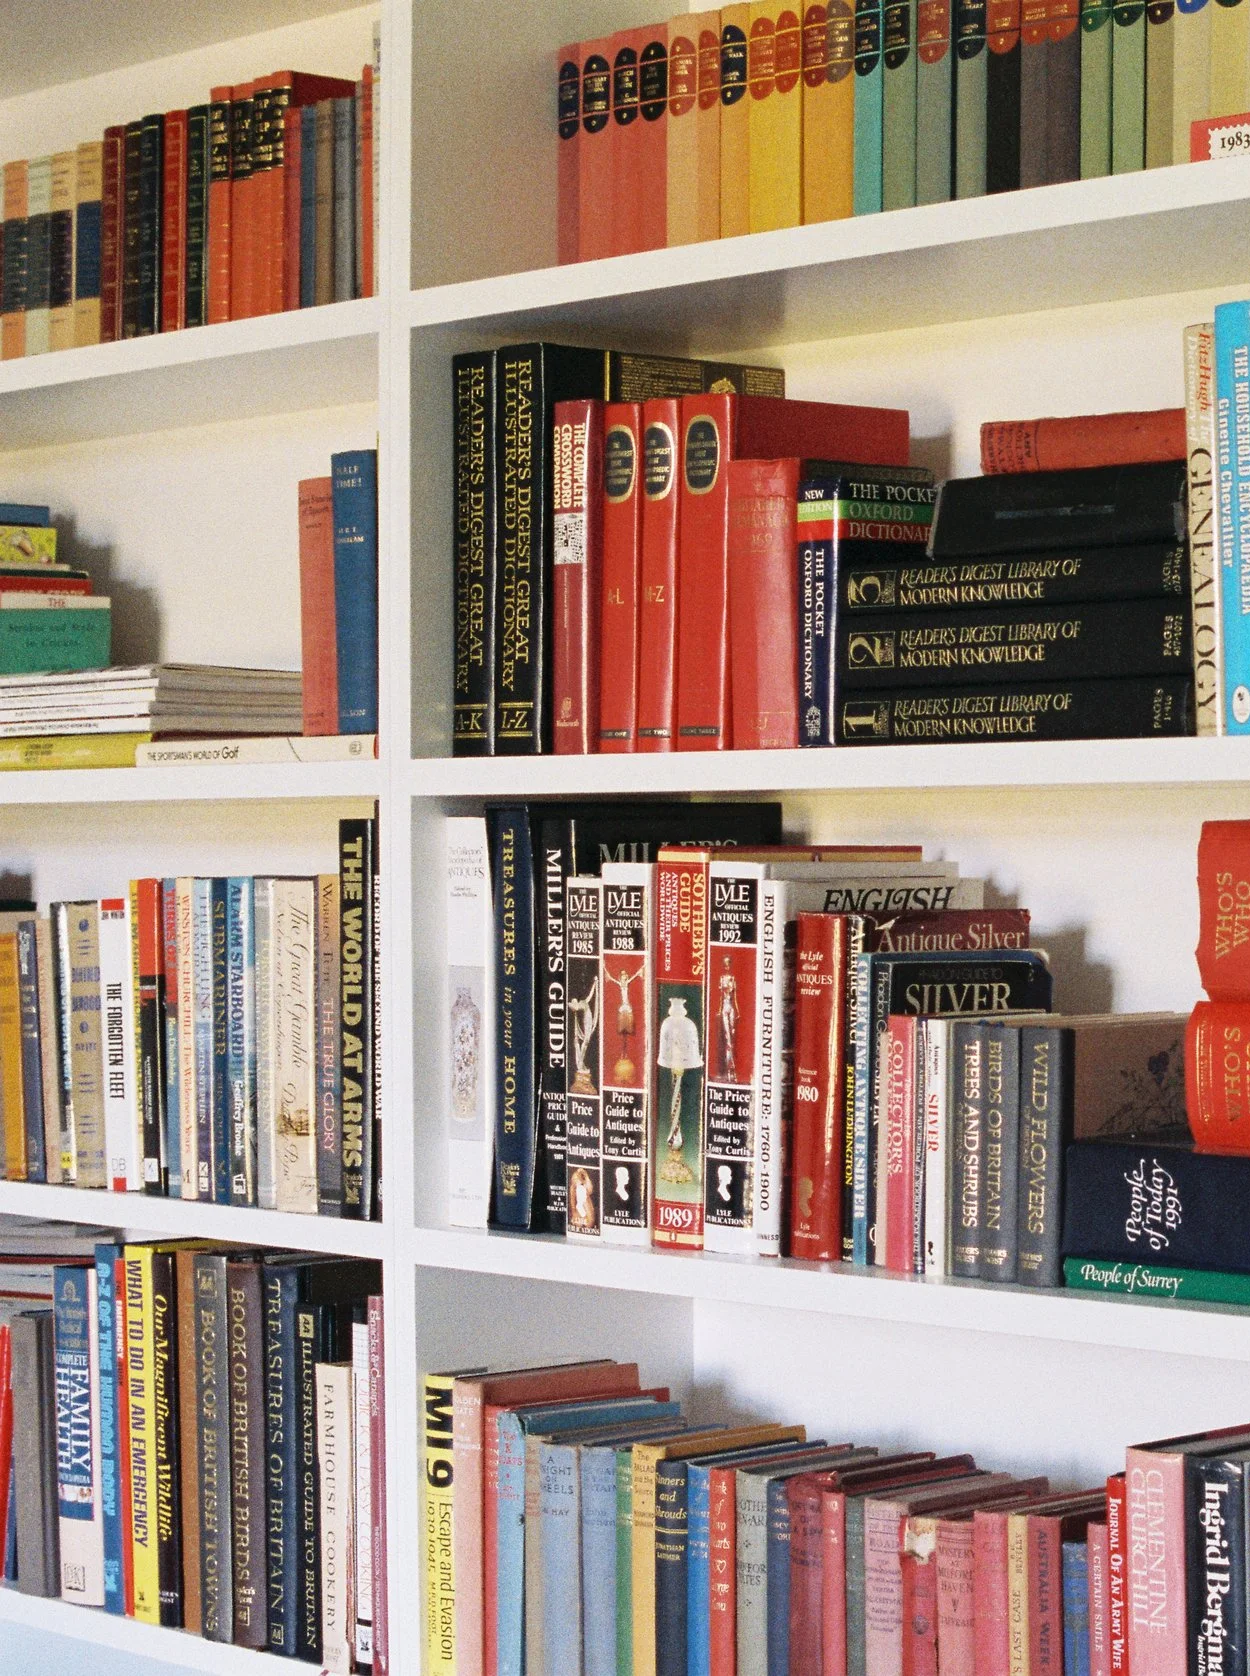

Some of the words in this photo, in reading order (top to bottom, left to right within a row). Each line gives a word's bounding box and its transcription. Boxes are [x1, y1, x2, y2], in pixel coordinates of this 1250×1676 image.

[1220, 132, 1250, 150] 1983
[1234, 346, 1250, 378] THE
[518, 360, 533, 480] READER'S
[561, 424, 573, 508] CROSSWORD
[804, 488, 824, 500] NEW
[517, 486, 533, 573] DIGEST
[849, 503, 914, 521] OXFORD
[804, 549, 813, 609] OXFORD
[815, 549, 824, 577] THE
[516, 580, 533, 663] GREAT
[814, 581, 824, 636] POCKET
[900, 627, 956, 649] READER'S
[959, 625, 1005, 643] DIGEST
[1008, 622, 1059, 641] LIBRARY
[1062, 620, 1081, 638] OF
[804, 612, 813, 699] DICTIONARY
[900, 649, 958, 668] MODERN
[962, 644, 1046, 665] KNOWLEDGE
[502, 711, 528, 729] L-Z
[343, 837, 363, 900] THE
[502, 828, 515, 976] TREASURES
[546, 848, 565, 973] MILLER'S
[679, 872, 691, 933] GUIDE
[692, 872, 705, 976] SOTHEBY'S
[1215, 872, 1234, 959] WHO'S
[342, 907, 364, 1026] WORLD
[878, 925, 963, 952] Antique
[967, 923, 1024, 950] Silver
[107, 983, 122, 1001] THE
[504, 986, 516, 1003] in
[905, 982, 1012, 1014] SILVER
[107, 1006, 124, 1066] FORGOTTEN
[343, 1031, 364, 1073] AT
[501, 1009, 514, 1049] your
[549, 982, 566, 1068] GUIDE
[109, 1071, 126, 1100] FLEET
[504, 1055, 517, 1134] HOME
[964, 1041, 980, 1099] TREES
[988, 1040, 1003, 1103] BIRDS
[1032, 1042, 1049, 1111] WILD
[1223, 1026, 1244, 1122] WHO'S
[343, 1077, 364, 1167] ARMS
[927, 1094, 939, 1152] SILVER
[964, 1102, 980, 1151] AND
[987, 1108, 1002, 1138] OF
[962, 1154, 979, 1227] SHRUBS
[986, 1143, 1002, 1230] BRITAIN
[1028, 1118, 1047, 1234] FLOWERS
[1124, 1159, 1148, 1242] People
[1143, 1158, 1174, 1224] Today
[658, 1206, 693, 1228] 1989
[1142, 1221, 1170, 1250] of
[1164, 1186, 1183, 1231] 1991
[127, 1260, 143, 1312] WHAT
[1080, 1263, 1122, 1288] People
[1123, 1265, 1142, 1293] of
[1136, 1270, 1183, 1298] Surrey
[129, 1319, 144, 1341] TO
[230, 1286, 248, 1360] BOOK
[129, 1346, 145, 1371] DO
[131, 1377, 146, 1399] IN
[232, 1362, 248, 1395] OF
[267, 1278, 283, 1443] TREASURES
[56, 1368, 71, 1470] HEALTH
[70, 1369, 91, 1471] FAMILY
[131, 1404, 147, 1431] AN
[233, 1399, 249, 1500] BRITISH
[268, 1453, 284, 1492] OF
[324, 1384, 336, 1516] FARMHOUSE
[426, 1459, 455, 1490] 9
[131, 1436, 149, 1548] EMERGENCY
[235, 1505, 251, 1580] BIRDS
[269, 1499, 285, 1613] BRITAIN
[435, 1501, 455, 1558] Escape
[1130, 1468, 1149, 1632] CHURCHILL
[1145, 1469, 1167, 1635] CLEMENTINE
[325, 1531, 336, 1631] COOKERY
[439, 1561, 456, 1592] and
[439, 1597, 456, 1661] Evasion
